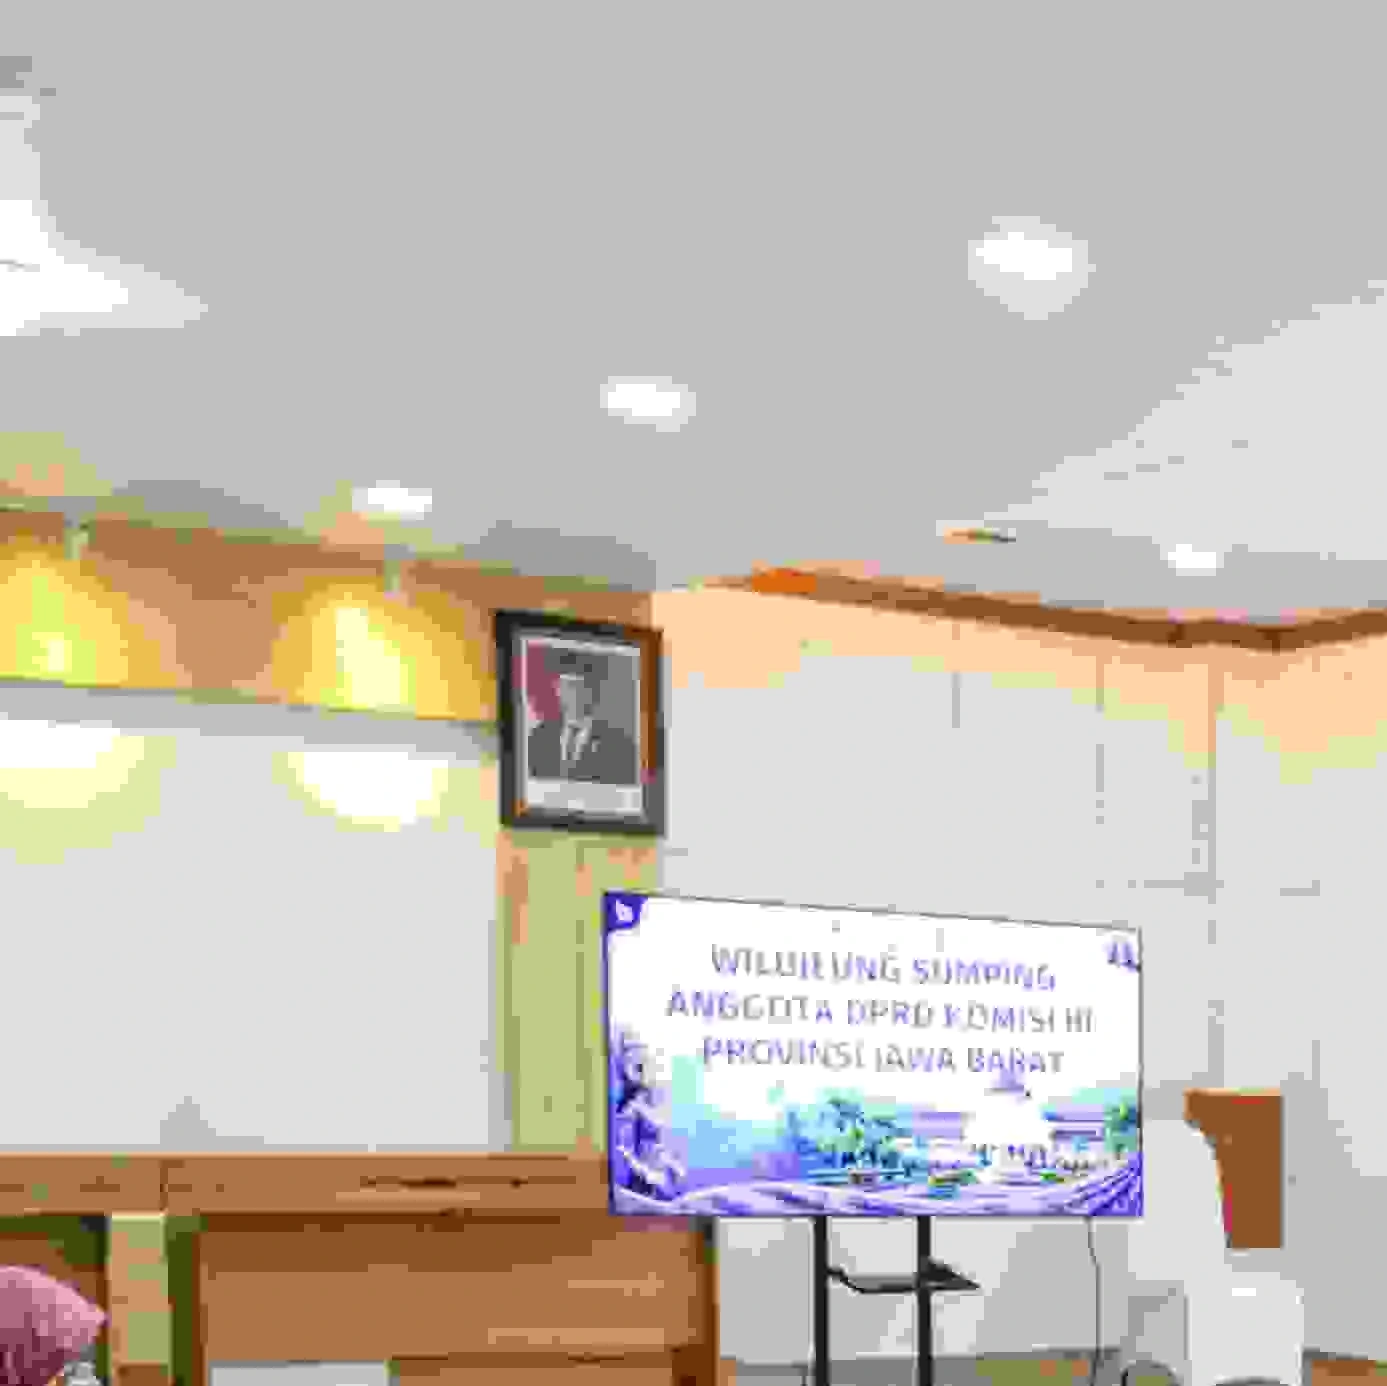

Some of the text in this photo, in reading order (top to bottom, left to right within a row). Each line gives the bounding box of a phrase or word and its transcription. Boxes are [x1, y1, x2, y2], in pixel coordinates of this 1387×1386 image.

[912, 957, 1056, 991] SUMPING
[665, 989, 833, 1024] ANGGOTA
[847, 999, 934, 1027] DPRD
[942, 1003, 1055, 1033] KOMISI
[703, 1037, 1065, 1074] PROVINSI JAWA BARAT
